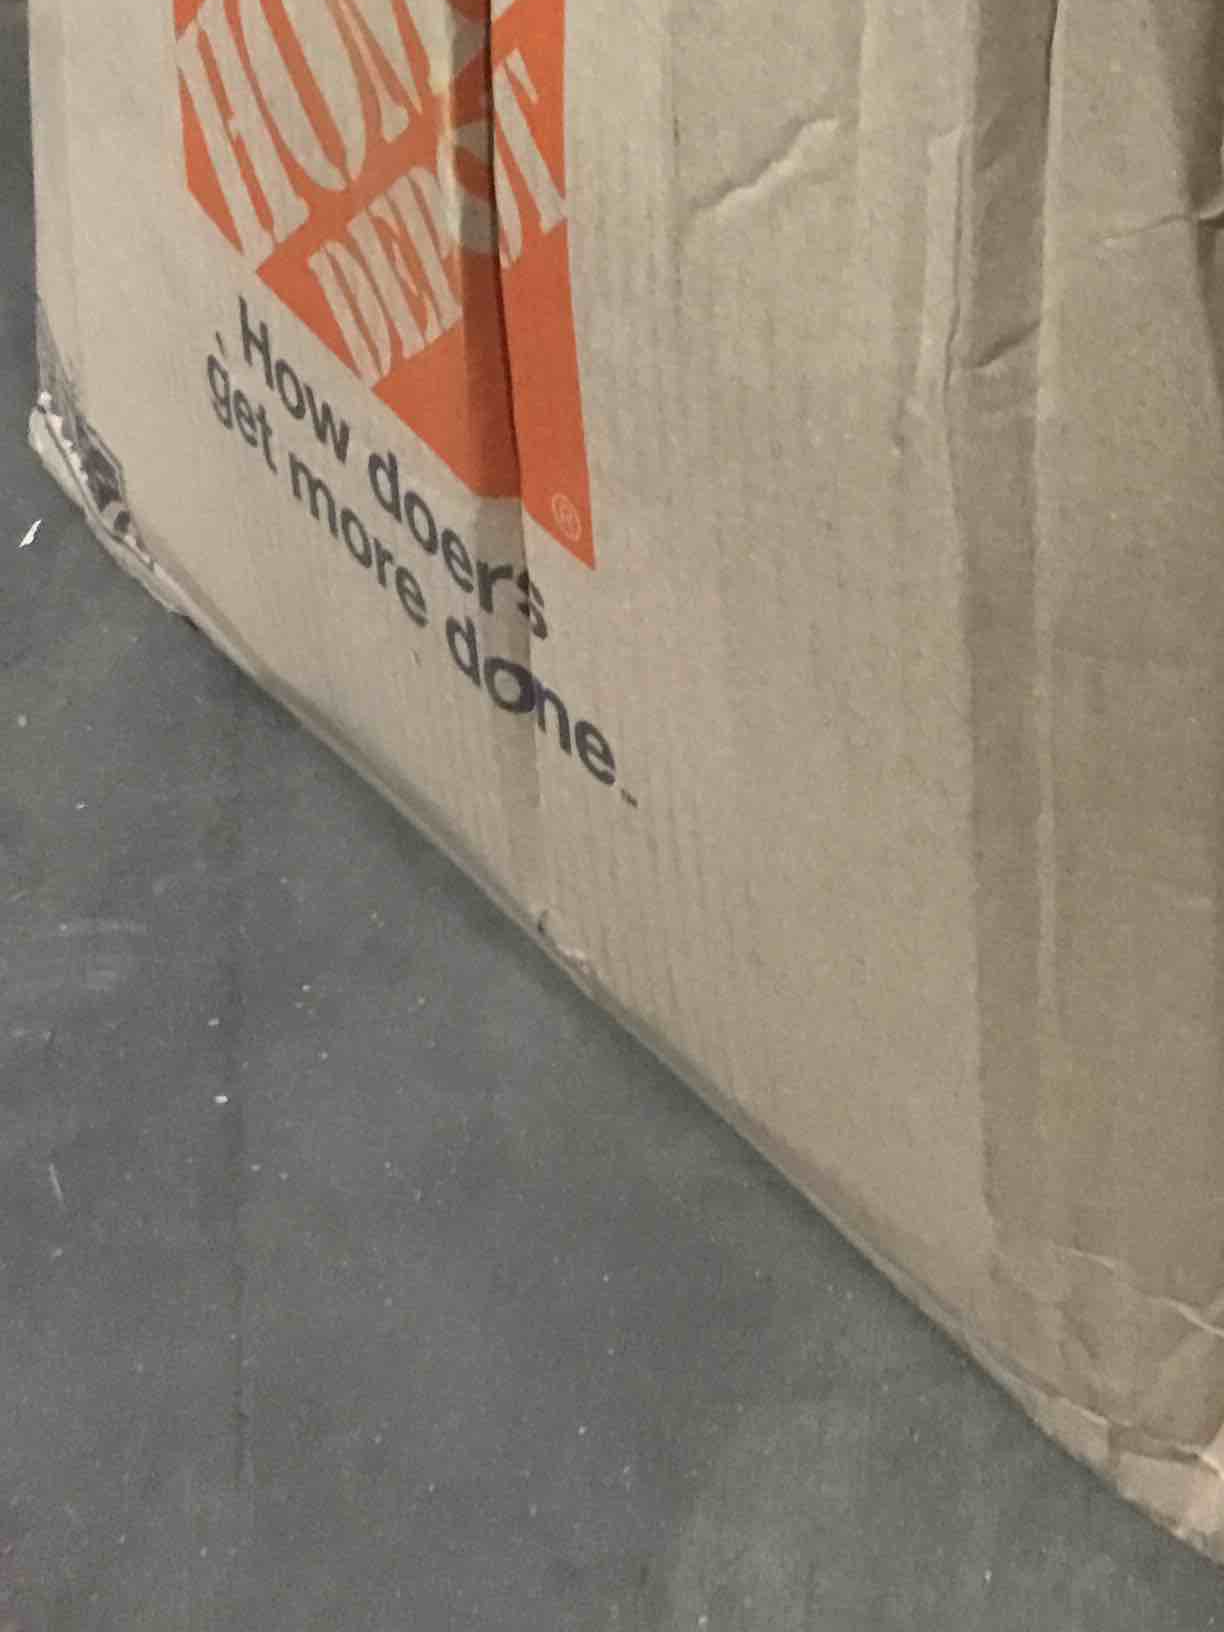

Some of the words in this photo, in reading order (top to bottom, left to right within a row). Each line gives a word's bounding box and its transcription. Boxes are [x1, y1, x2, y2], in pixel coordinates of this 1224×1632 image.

[206, 353, 277, 473] get
[288, 452, 428, 627] more
[238, 295, 350, 464] How
[368, 451, 549, 640] doers
